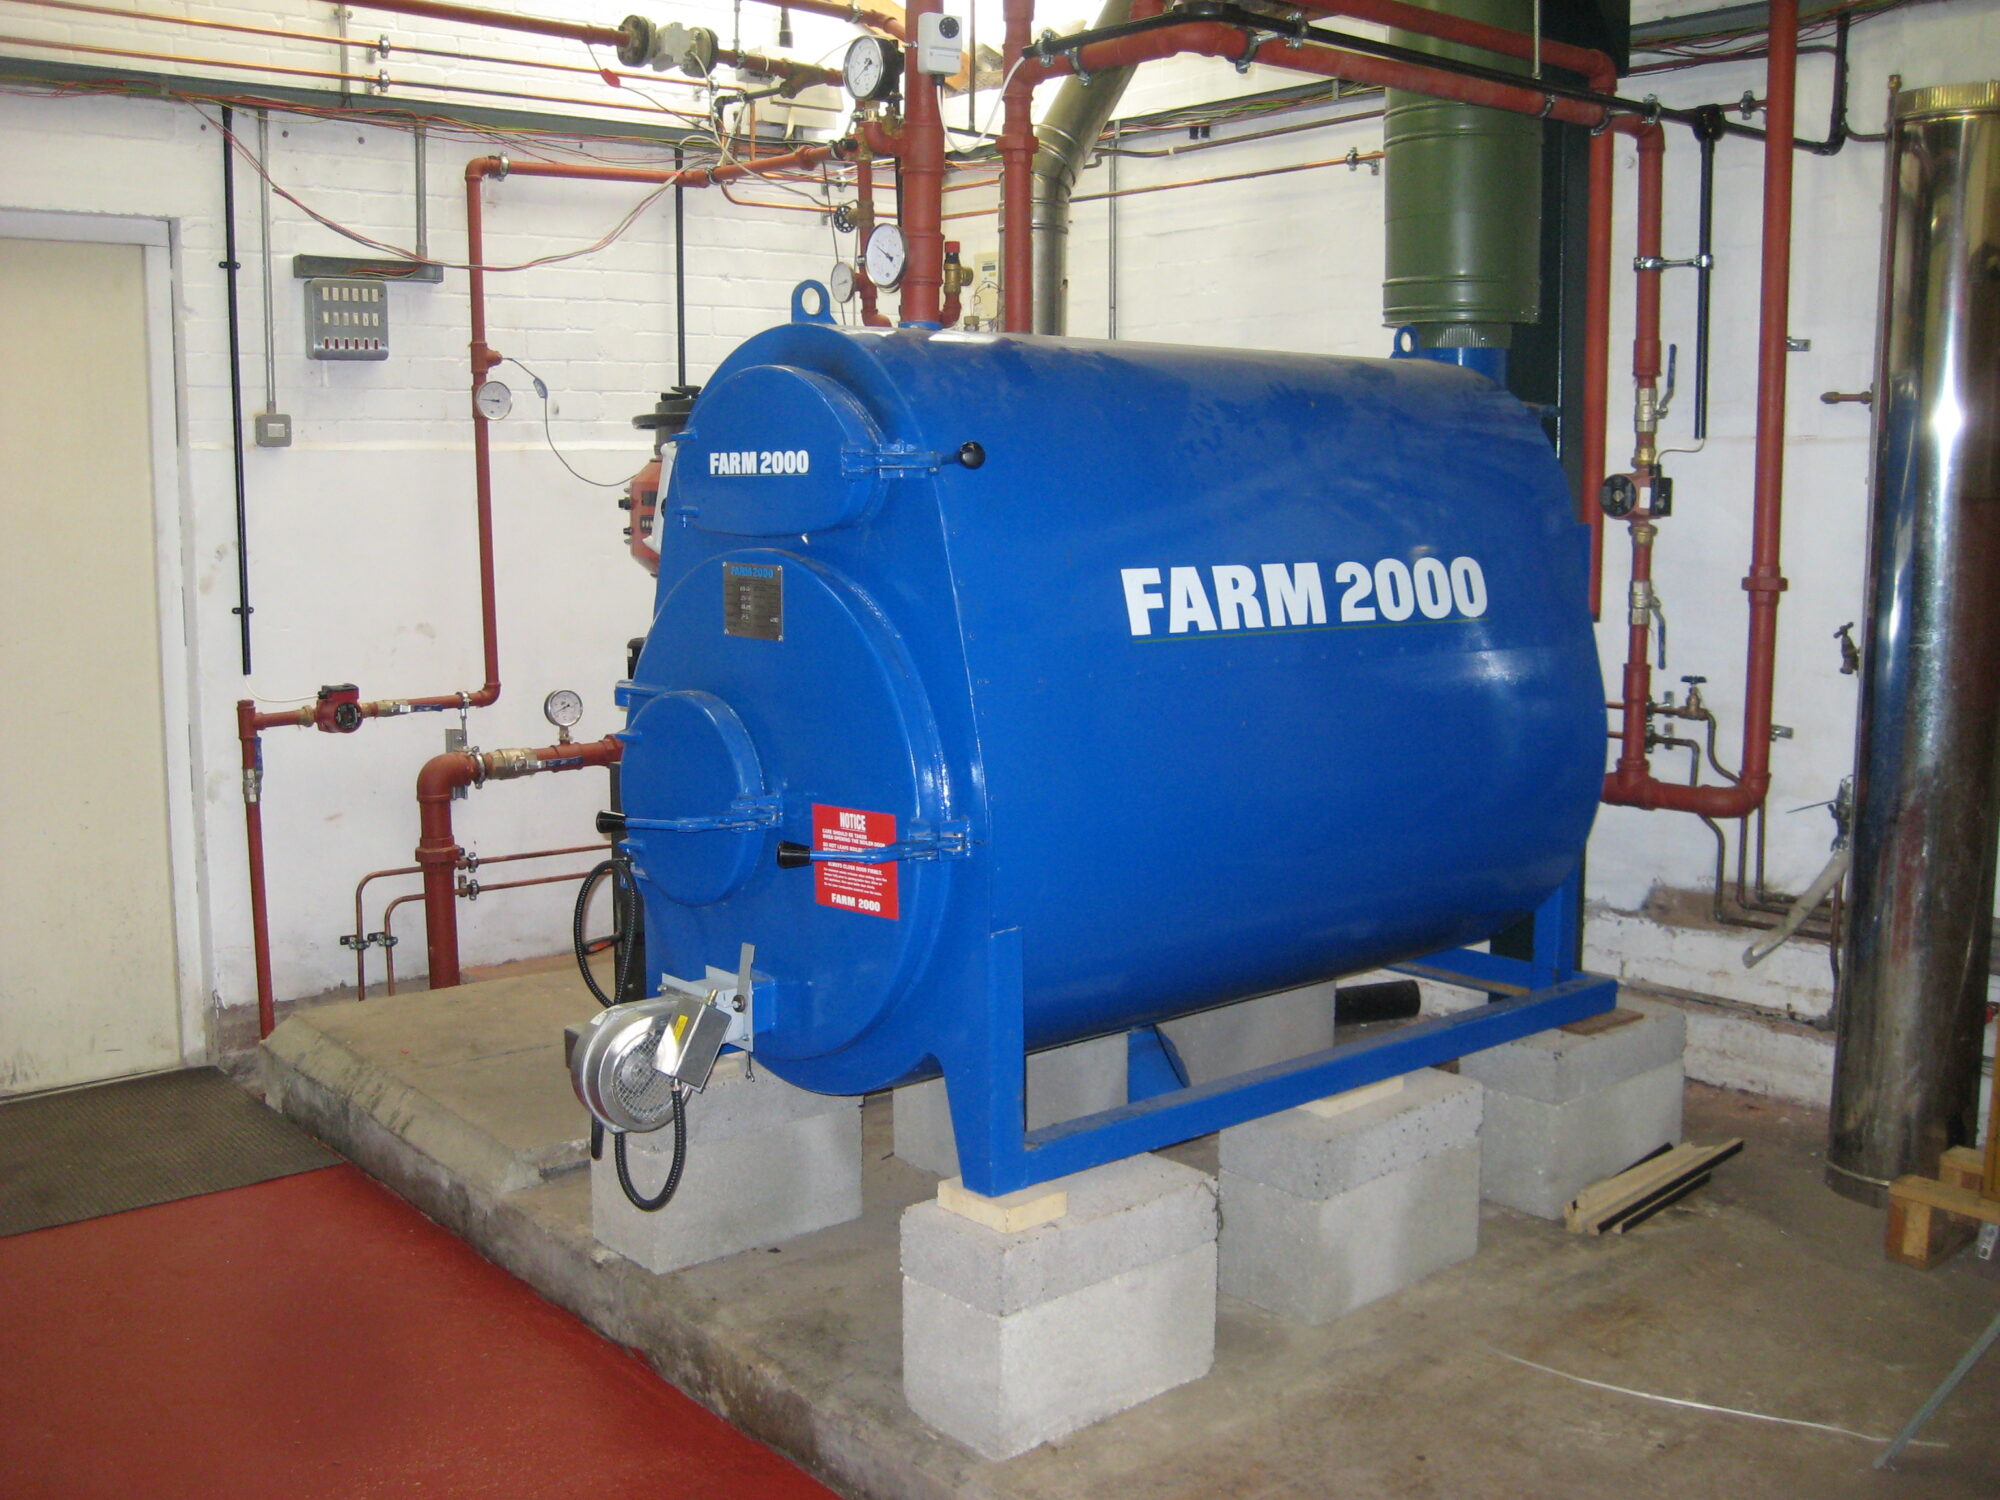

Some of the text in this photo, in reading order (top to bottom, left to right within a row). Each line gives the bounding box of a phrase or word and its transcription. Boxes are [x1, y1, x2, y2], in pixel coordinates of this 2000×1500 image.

[709, 450, 809, 475] FARM 2000
[731, 565, 774, 578] FARM 2000
[1120, 556, 1488, 636] FARM 2000
[839, 811, 867, 832] NOTICE
[831, 893, 881, 912] FARM 2000
